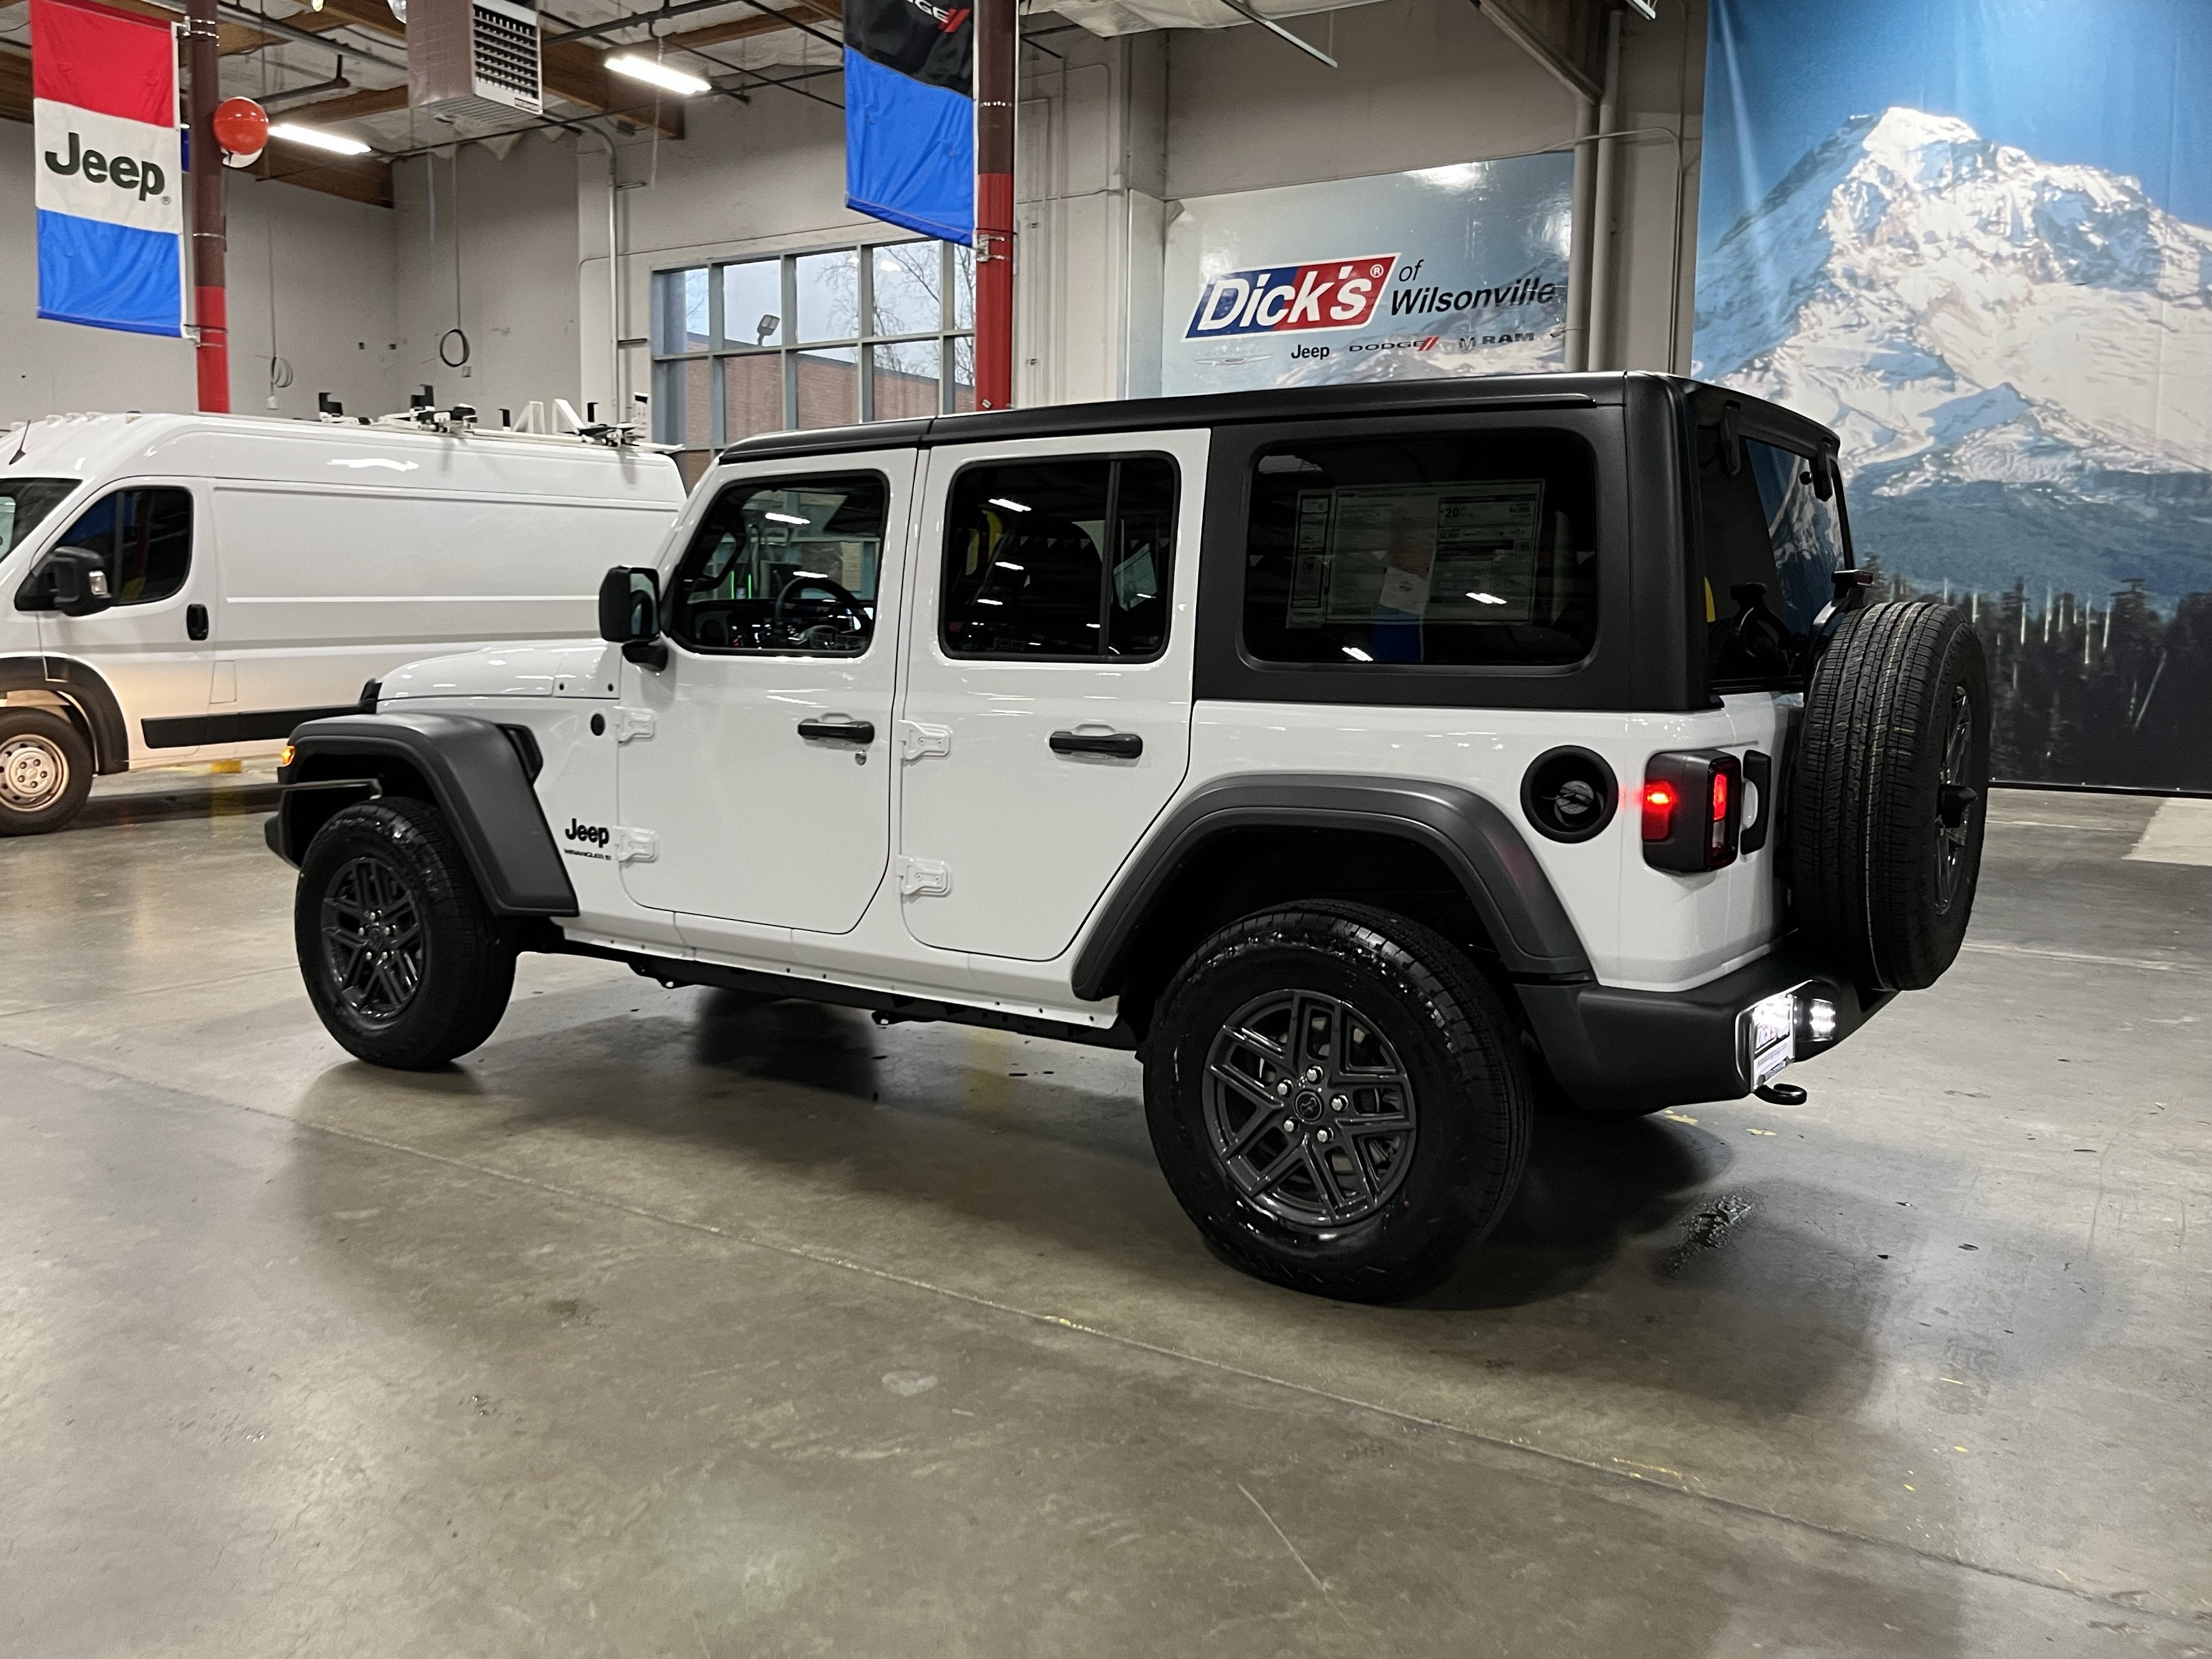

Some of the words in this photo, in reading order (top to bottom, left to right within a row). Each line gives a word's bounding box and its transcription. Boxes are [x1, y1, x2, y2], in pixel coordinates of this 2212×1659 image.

[45, 132, 165, 201] Jeep
[1398, 259, 1425, 281] of
[1391, 275, 1556, 315] Wilsonville
[1291, 344, 1330, 360] Jeep
[1349, 340, 1426, 352] DODGE
[1482, 332, 1534, 345] RAM
[1445, 507, 1459, 517] 20
[565, 818, 609, 848] Jeep
